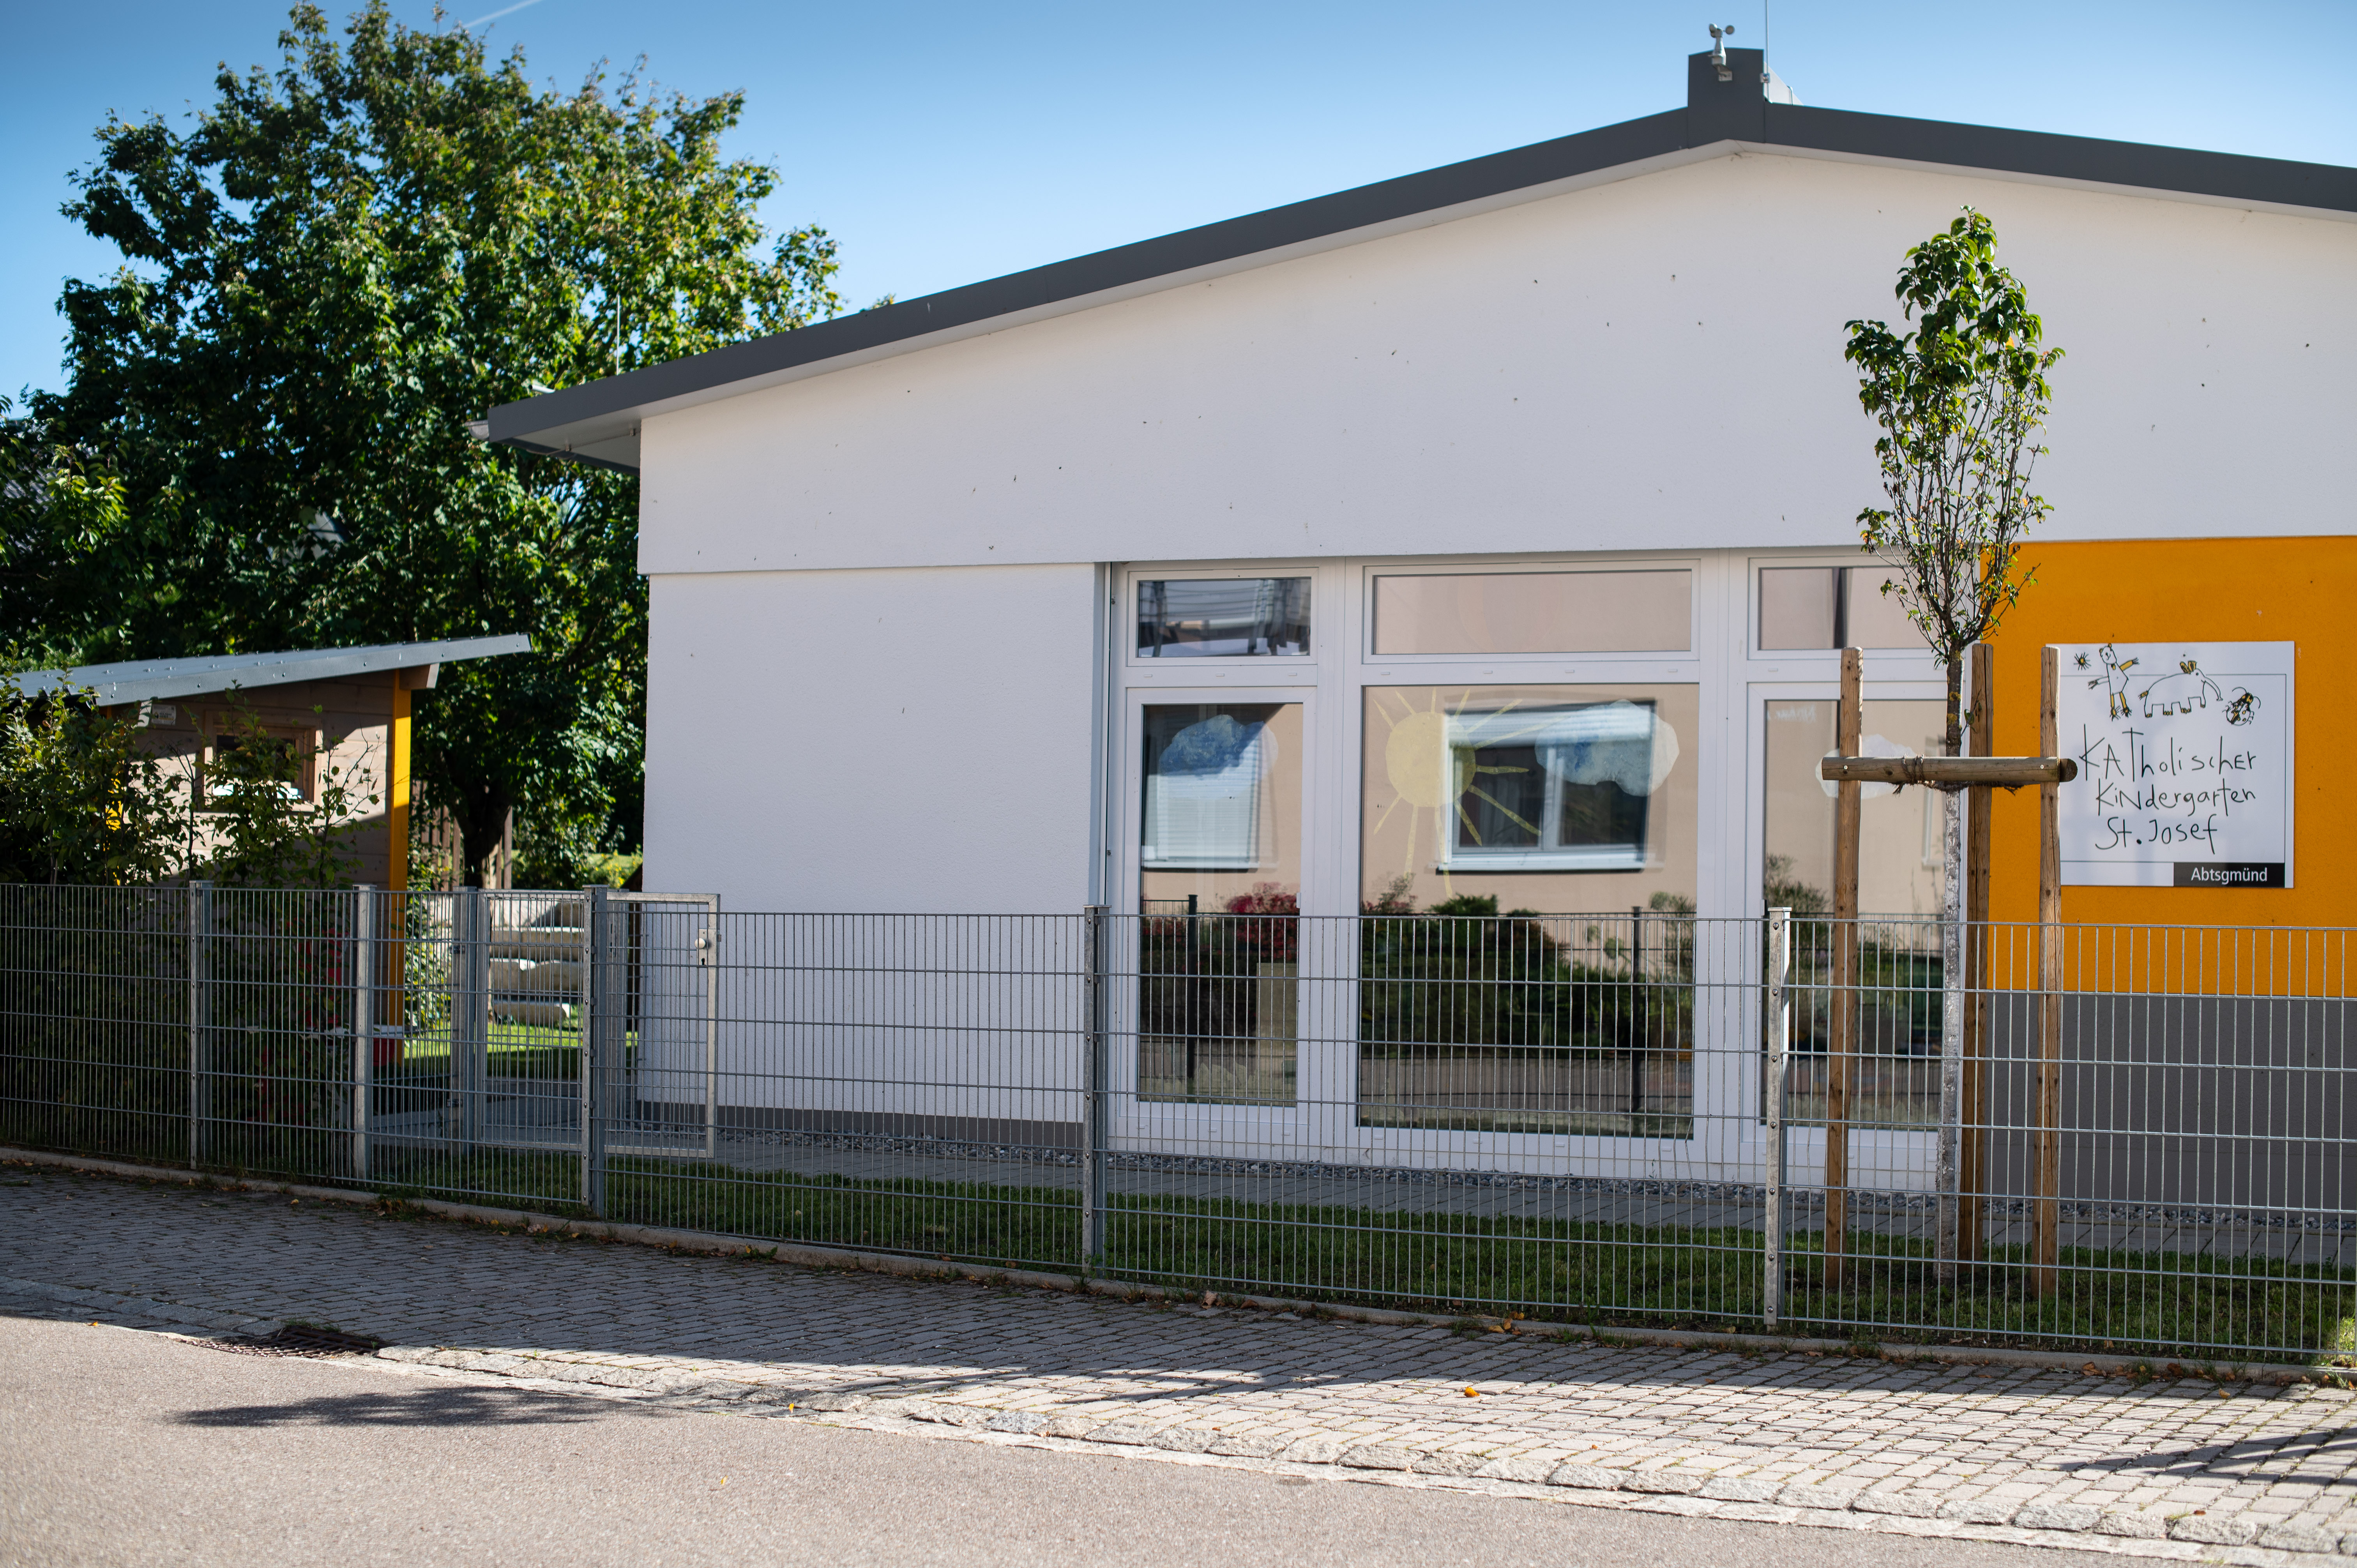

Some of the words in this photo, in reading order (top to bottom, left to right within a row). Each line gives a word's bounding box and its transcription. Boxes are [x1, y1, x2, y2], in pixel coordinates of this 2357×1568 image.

[2095, 816, 2142, 850] St.
[2149, 814, 2218, 855] Josef
[2191, 867, 2267, 884] Abtsgmünd
